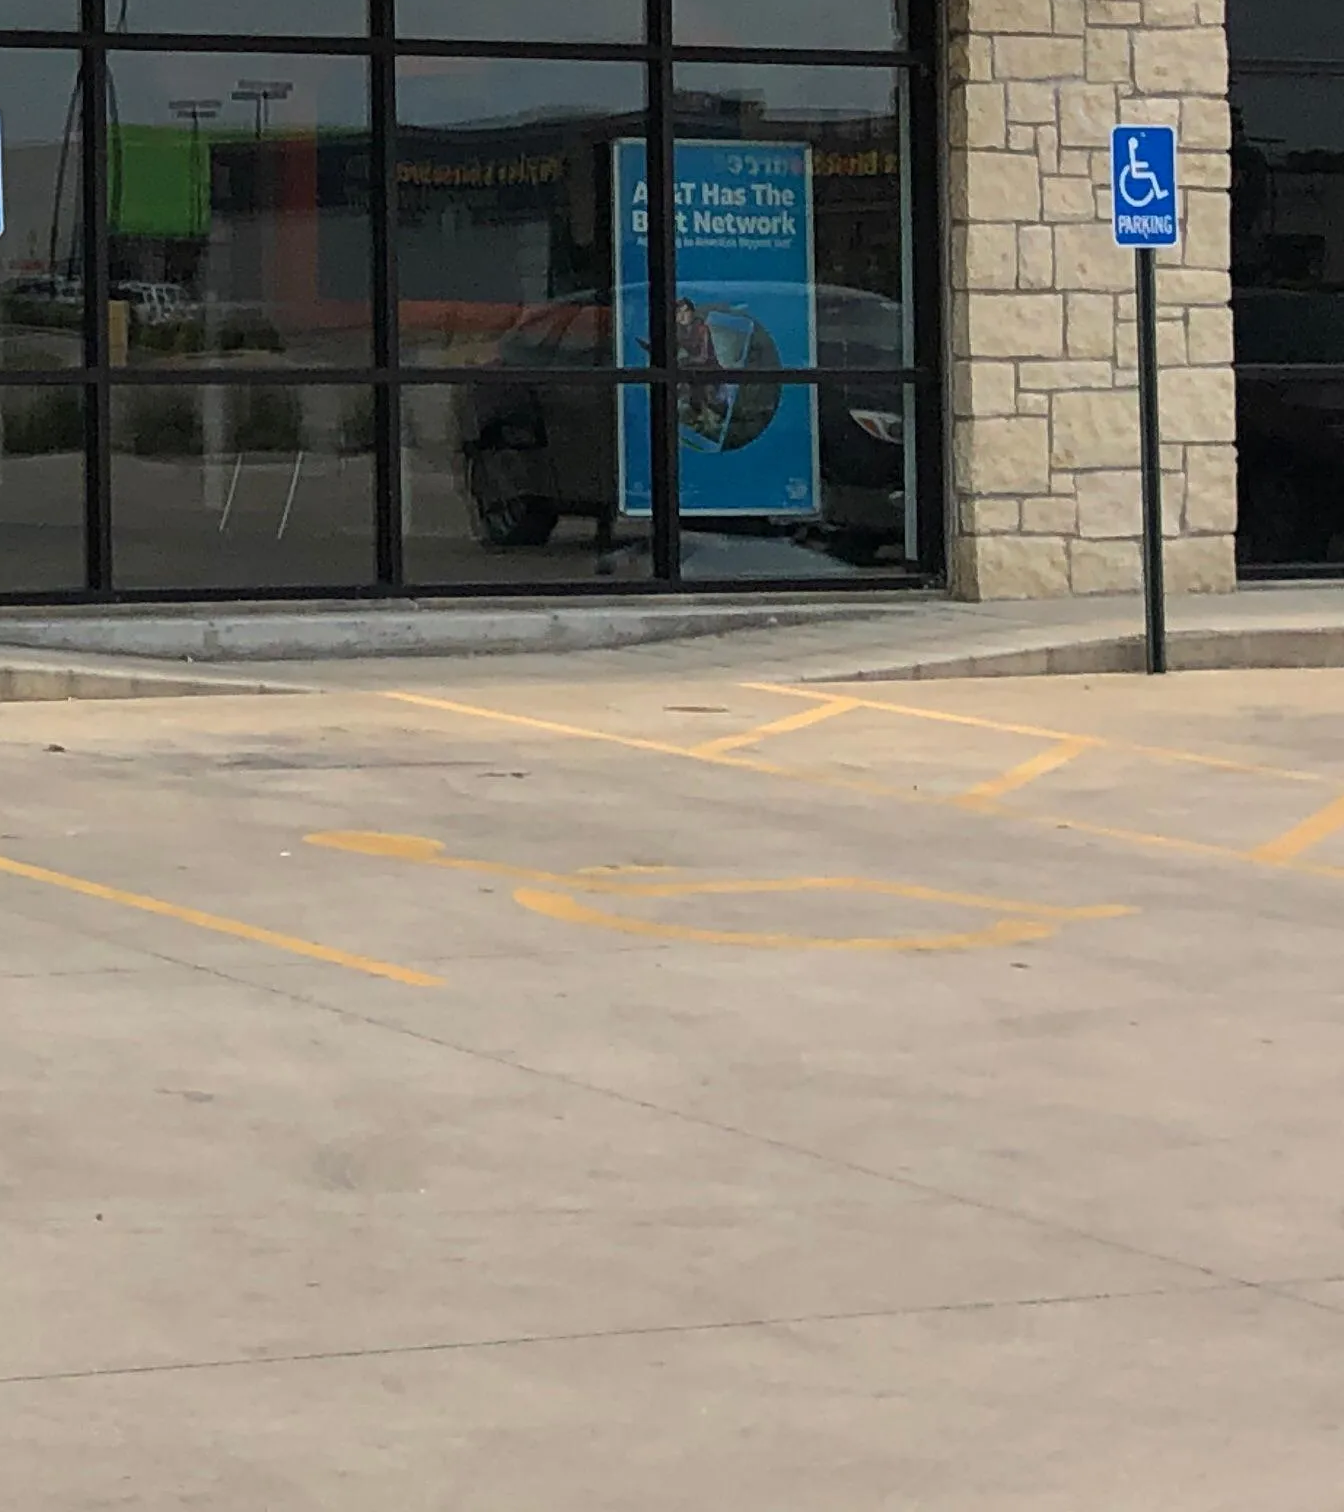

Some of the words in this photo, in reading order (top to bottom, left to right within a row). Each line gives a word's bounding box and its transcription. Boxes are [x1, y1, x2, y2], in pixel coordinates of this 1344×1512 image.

[632, 181, 697, 206] AT
[701, 183, 747, 207] Has
[750, 182, 796, 207] The
[632, 210, 688, 234] Bt
[693, 210, 797, 236] Network
[1117, 214, 1173, 235] PARKING
